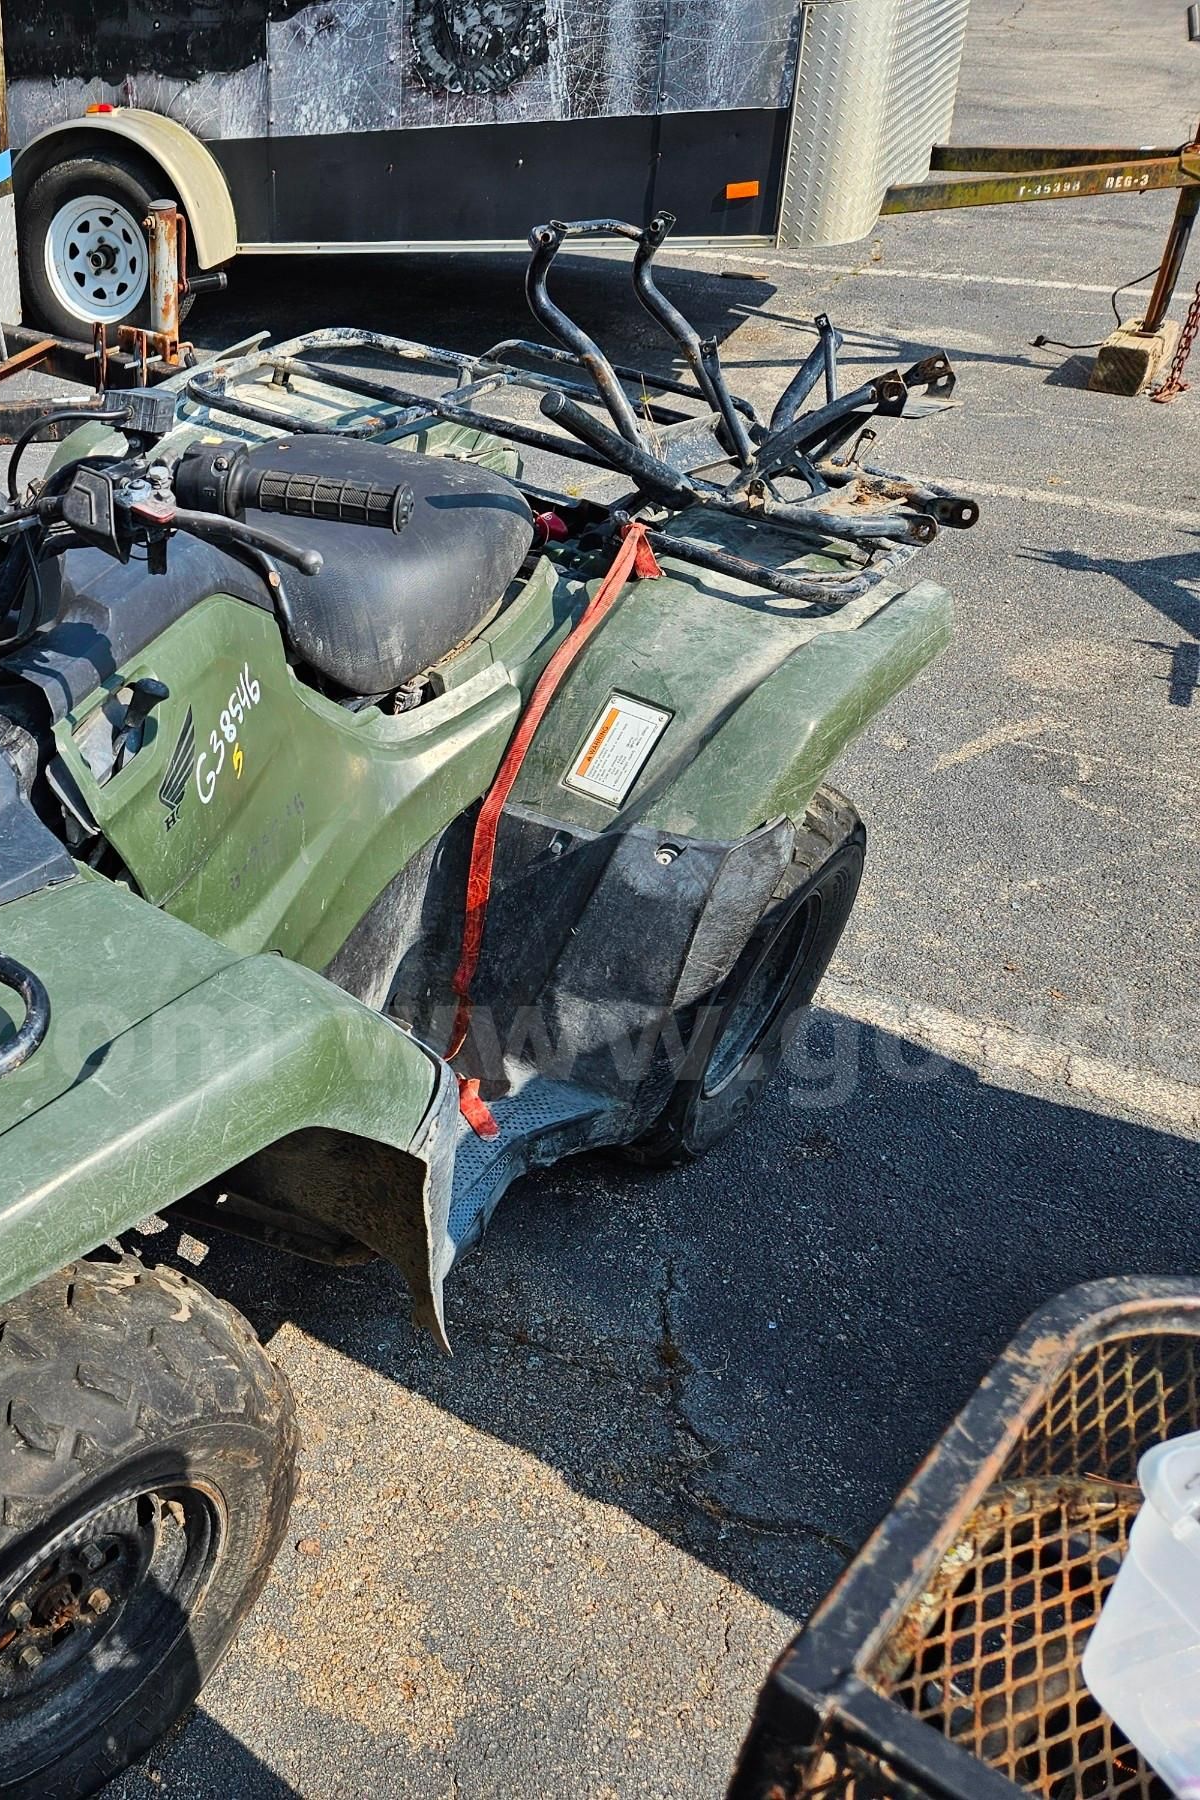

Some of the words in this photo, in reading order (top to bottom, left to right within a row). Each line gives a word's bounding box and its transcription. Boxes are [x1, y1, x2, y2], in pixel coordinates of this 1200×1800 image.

[1105, 174, 1149, 189] REG-3
[196, 662, 261, 804] G38546
[588, 725, 609, 756] WARNING
